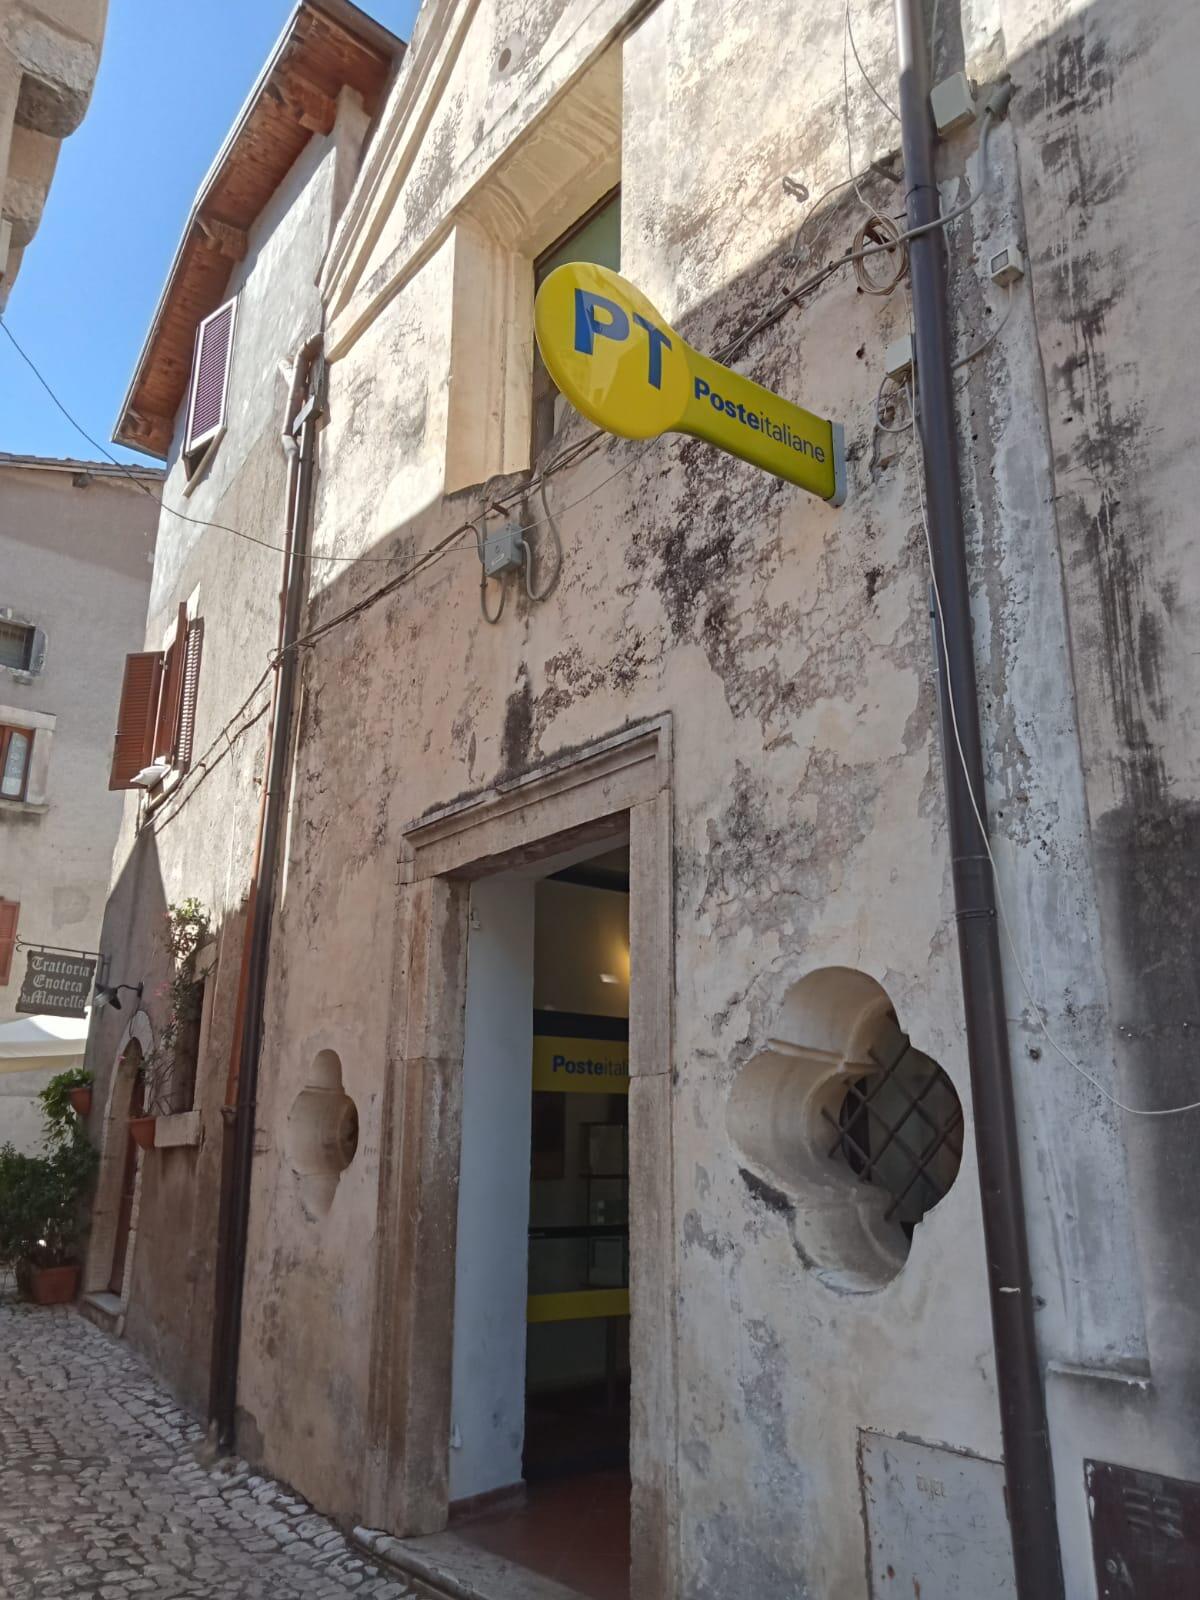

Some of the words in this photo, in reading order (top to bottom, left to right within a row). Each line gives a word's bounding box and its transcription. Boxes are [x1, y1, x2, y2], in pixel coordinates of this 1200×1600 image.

[574, 288, 672, 390] PT
[32, 956, 90, 977] Trattoria
[33, 974, 82, 992] Enoteca
[31, 990, 85, 1009] Marcello
